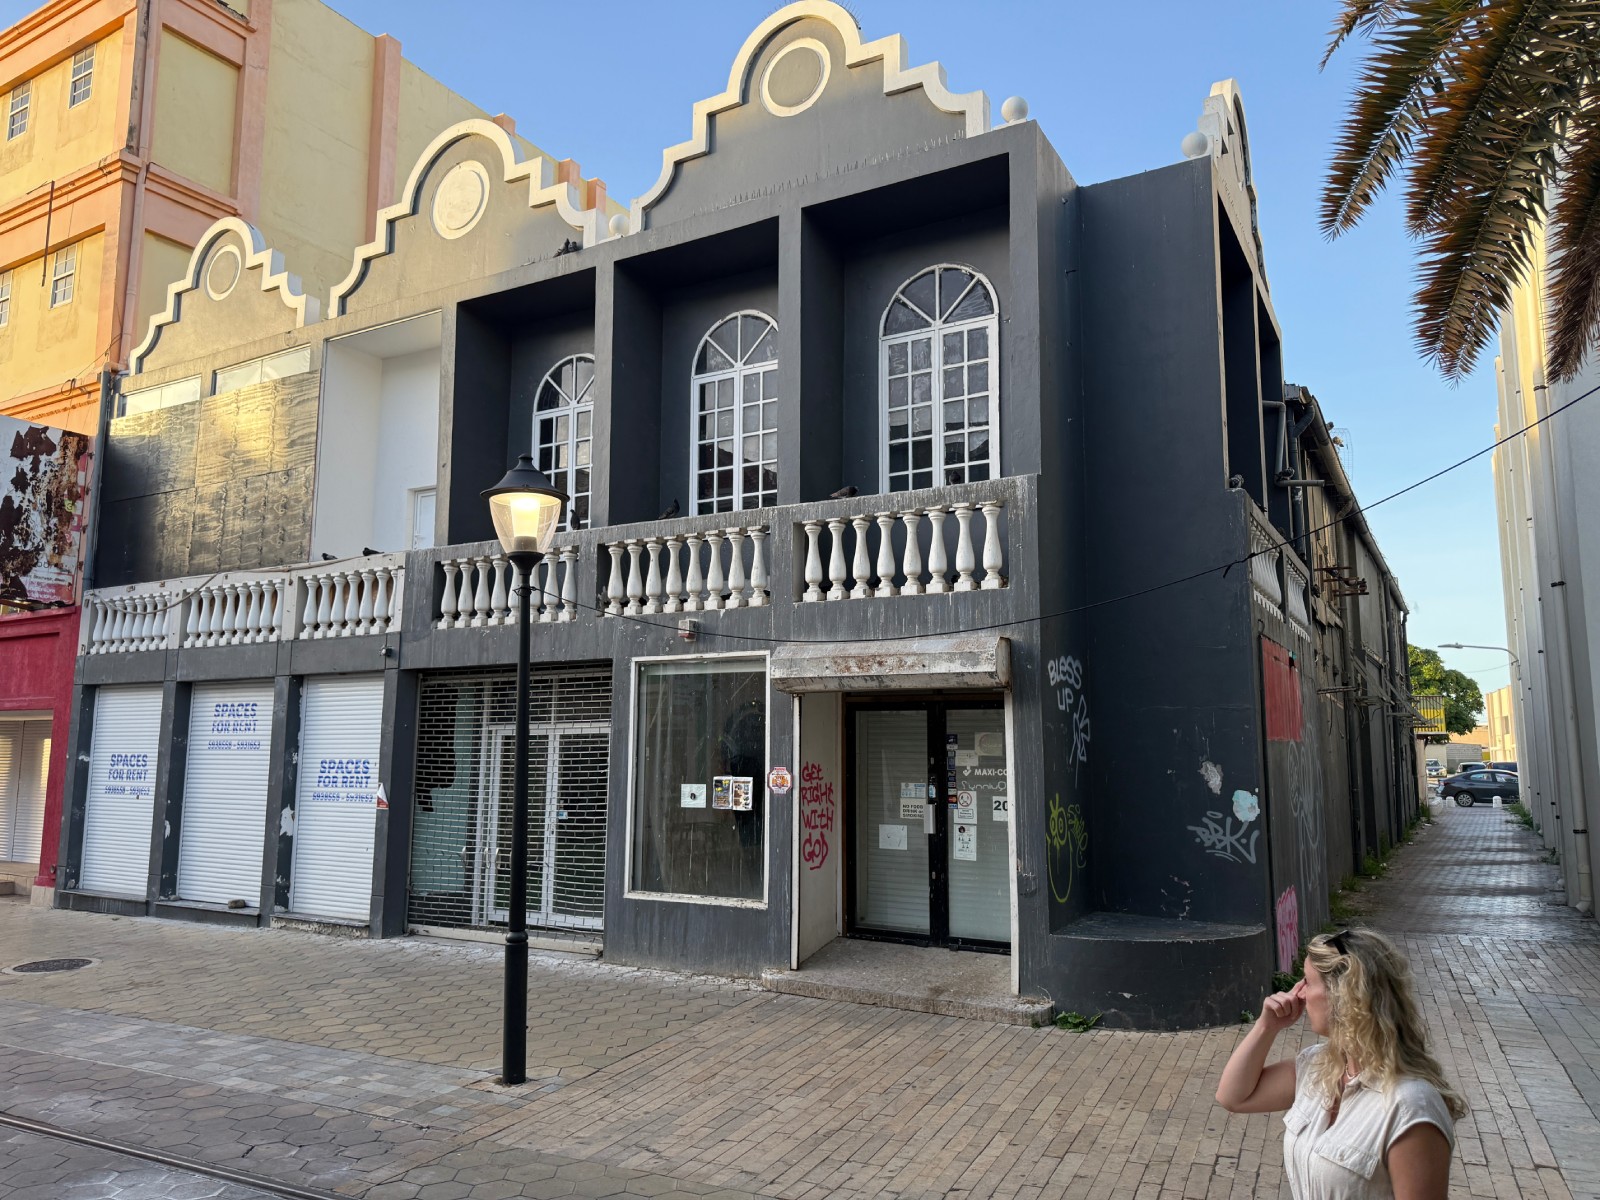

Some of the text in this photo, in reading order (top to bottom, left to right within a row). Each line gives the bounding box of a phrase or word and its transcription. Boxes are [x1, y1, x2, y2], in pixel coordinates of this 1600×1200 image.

[1057, 688, 1074, 712] UP
[214, 703, 258, 718] SPACES
[211, 719, 258, 733] FOR RENT
[110, 754, 148, 767] SPACES
[320, 759, 370, 774] SPACES
[108, 769, 148, 781] FOR RENT
[317, 775, 371, 788] FOR RENT
[803, 831, 829, 870] GOD
